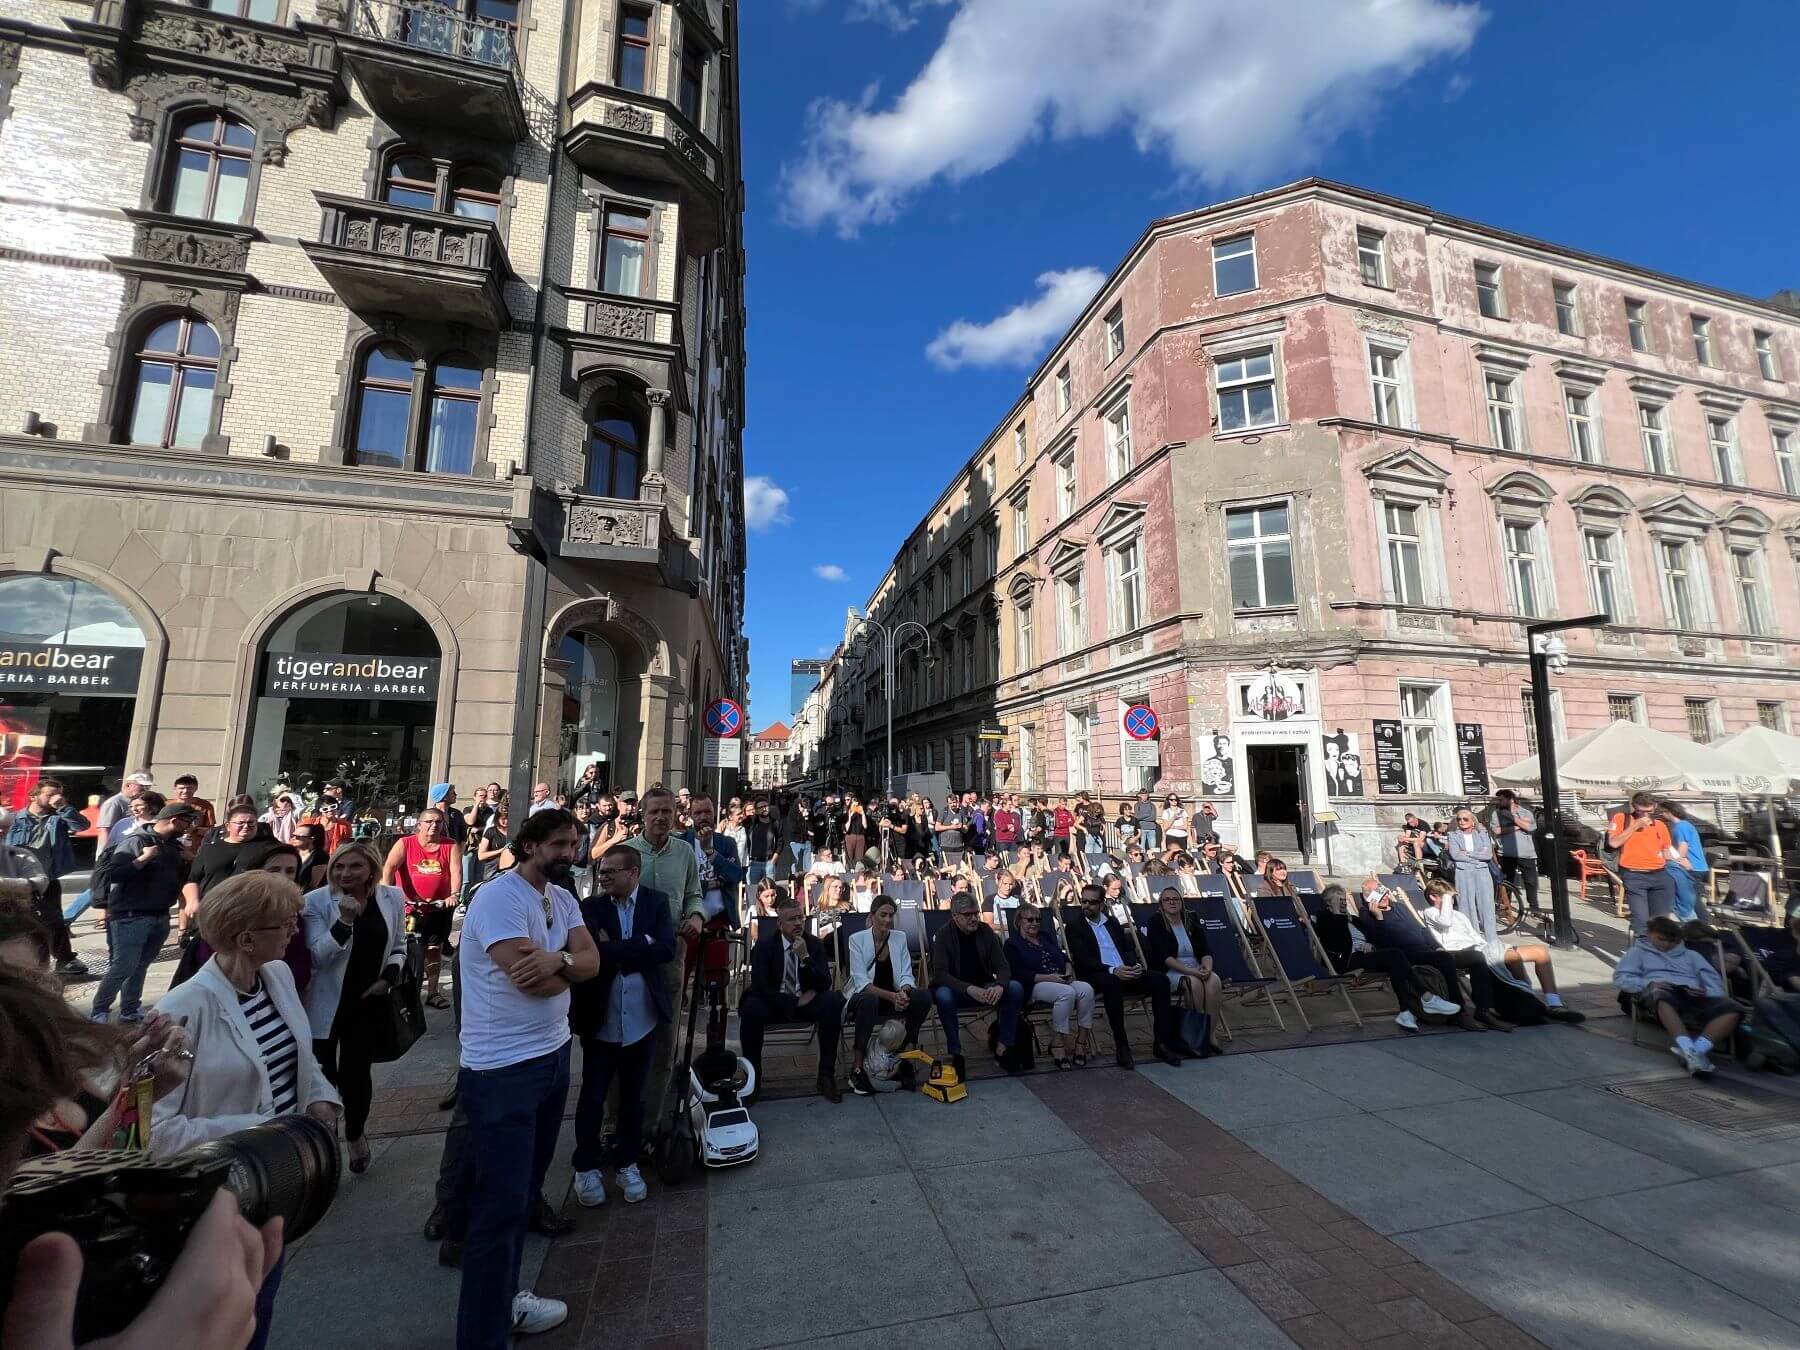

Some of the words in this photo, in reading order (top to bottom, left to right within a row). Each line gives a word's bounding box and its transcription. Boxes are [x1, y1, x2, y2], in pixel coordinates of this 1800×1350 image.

[0, 647, 115, 669] andbear
[277, 656, 428, 680] tigerandbear
[47, 675, 110, 686] BARBER
[273, 681, 363, 692] PERFUMERIA
[374, 684, 426, 694] BARBER
